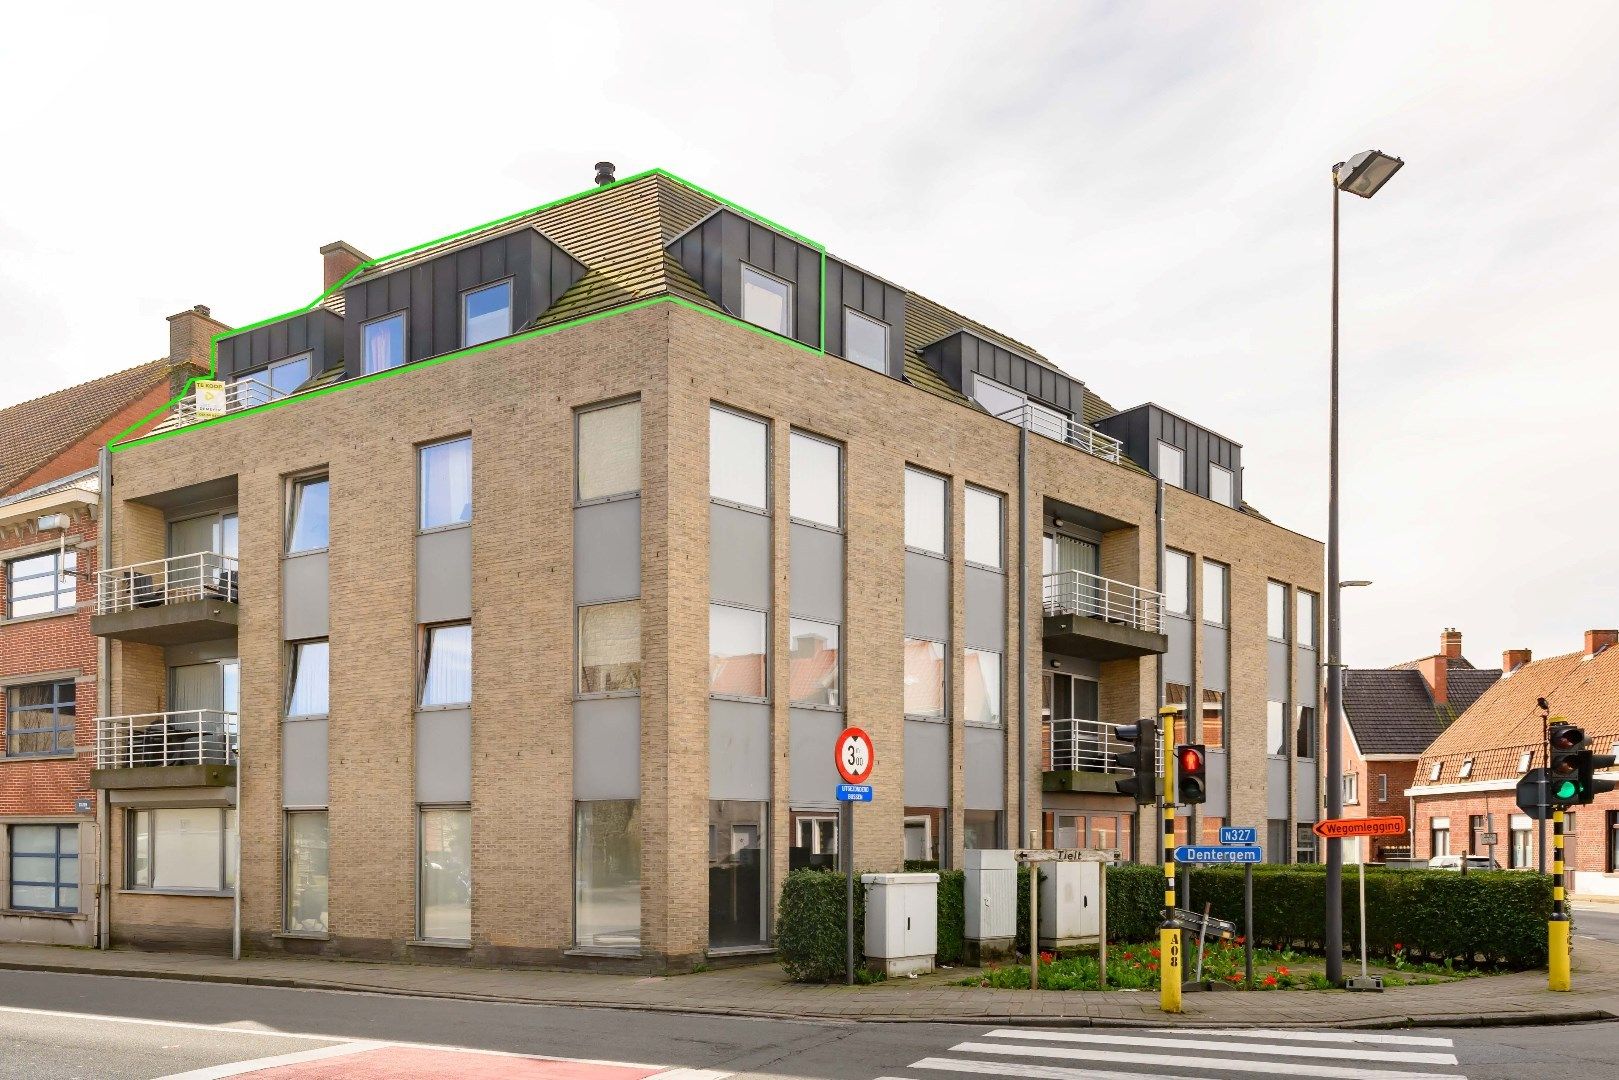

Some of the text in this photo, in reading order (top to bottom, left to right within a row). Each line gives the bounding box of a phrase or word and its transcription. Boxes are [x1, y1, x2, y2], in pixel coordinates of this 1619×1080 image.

[847, 745, 855, 766] 3
[1225, 829, 1251, 841] N327
[1326, 822, 1400, 835] Wegomlegging
[1057, 850, 1082, 860] Tielt
[1187, 848, 1256, 862] Dentergem
